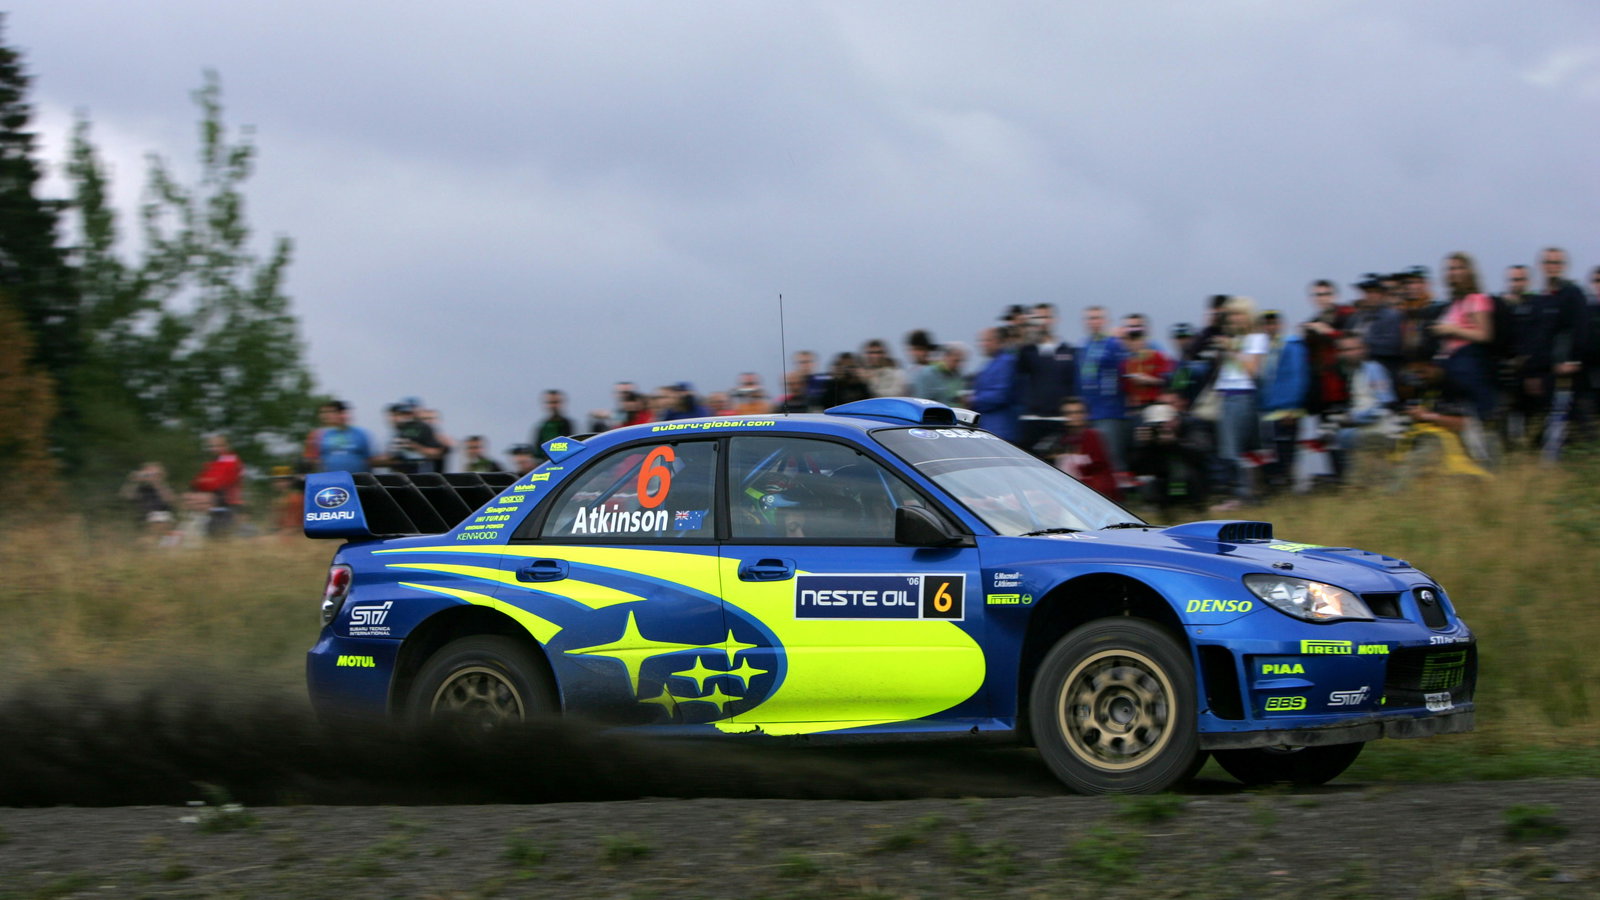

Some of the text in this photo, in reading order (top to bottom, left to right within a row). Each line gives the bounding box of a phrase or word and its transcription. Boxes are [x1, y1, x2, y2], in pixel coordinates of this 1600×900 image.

[652, 420, 776, 432] subaru-global.com
[637, 445, 675, 508] 6
[306, 511, 355, 521] SUBARU
[485, 506, 518, 514] Snap-on
[571, 504, 669, 534] Atkinson
[456, 531, 498, 540] KENWOOD
[906, 577, 919, 586] '06
[801, 590, 916, 606] NESTE OIL
[933, 582, 953, 613] 6
[987, 594, 1020, 604] PIRELLI
[1186, 599, 1253, 612] DENSO
[1300, 639, 1390, 654] PIRELLI MOTUL
[336, 655, 375, 667] MOTUL
[1262, 664, 1305, 674] PIAA
[1265, 696, 1307, 711] BBS
